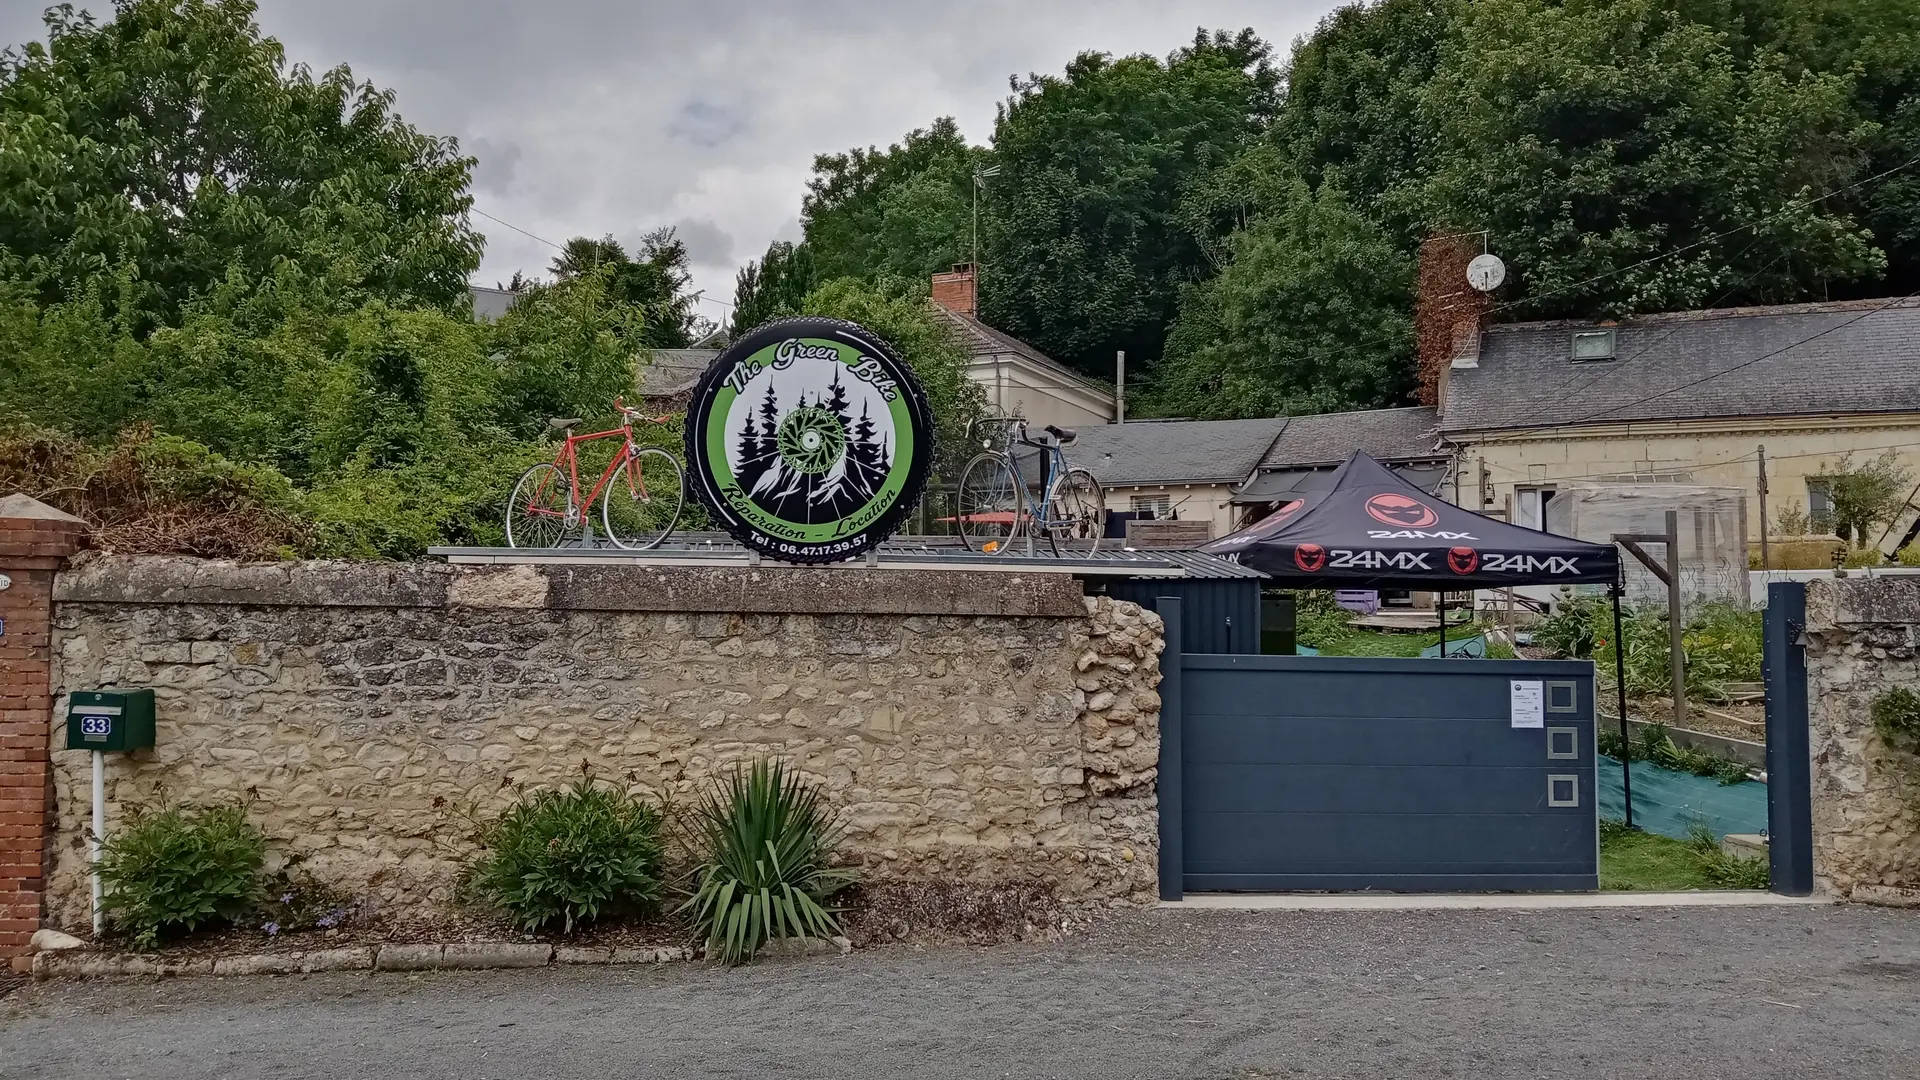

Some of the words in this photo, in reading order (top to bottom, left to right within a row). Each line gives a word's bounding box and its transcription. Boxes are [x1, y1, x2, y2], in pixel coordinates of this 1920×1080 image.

[722, 359, 763, 396] The
[771, 337, 840, 370] Green
[846, 355, 898, 403] Bike
[721, 482, 807, 541] Réparation
[830, 488, 897, 538] Location
[750, 529, 770, 547] Tel
[778, 532, 868, 557] 06.47.17.39.57
[1367, 530, 1480, 541] 24MX
[1329, 549, 1432, 570] 24MX
[1481, 553, 1582, 575] 24MX
[86, 719, 107, 733] 33
